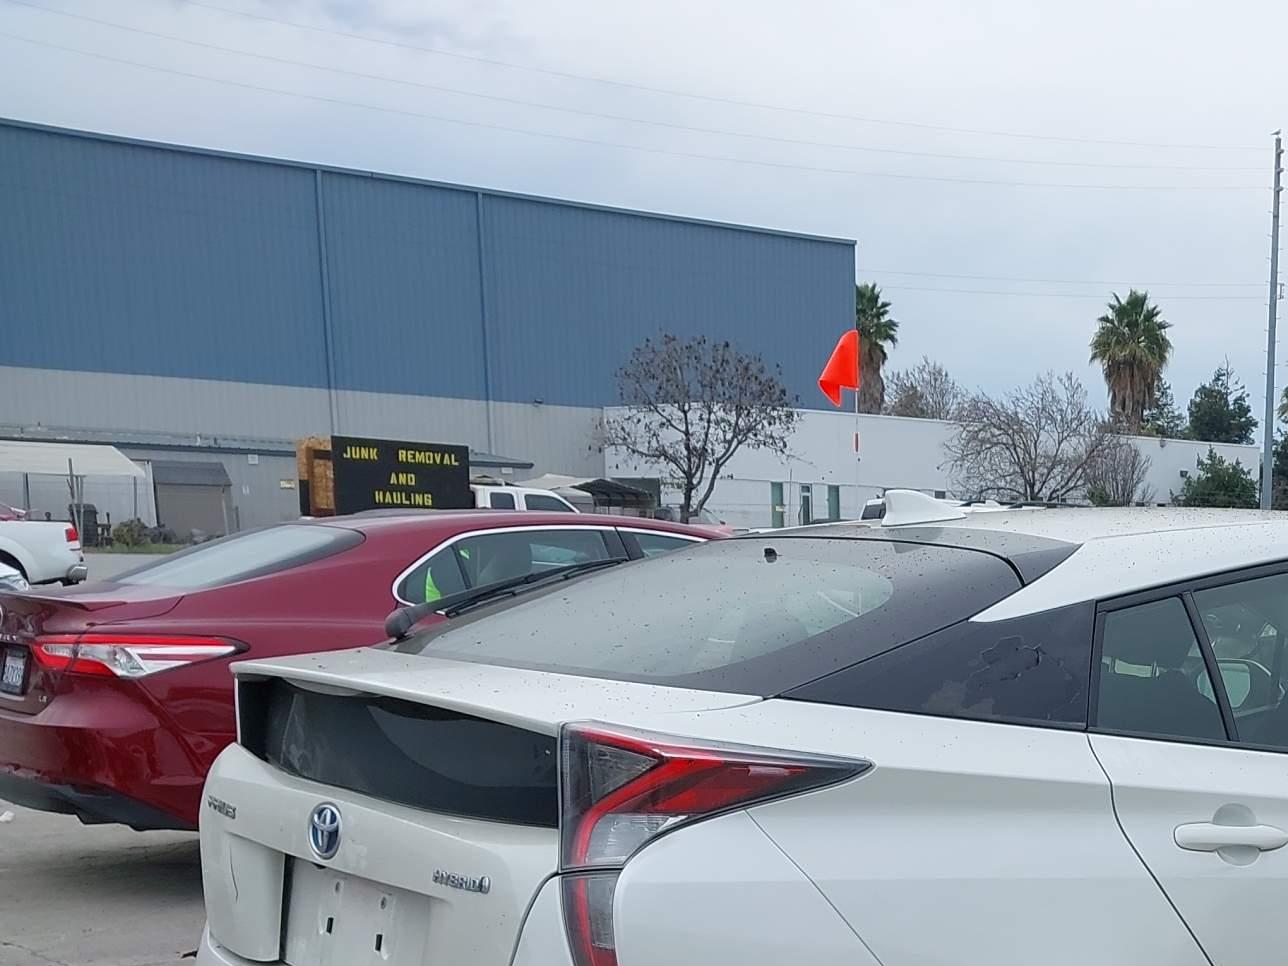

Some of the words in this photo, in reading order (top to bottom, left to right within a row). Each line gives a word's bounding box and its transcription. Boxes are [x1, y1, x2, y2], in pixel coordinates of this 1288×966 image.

[343, 446, 378, 460] JUNK
[398, 449, 459, 466] REMOVAL
[390, 472, 416, 486] AND
[375, 490, 432, 506] HAULING
